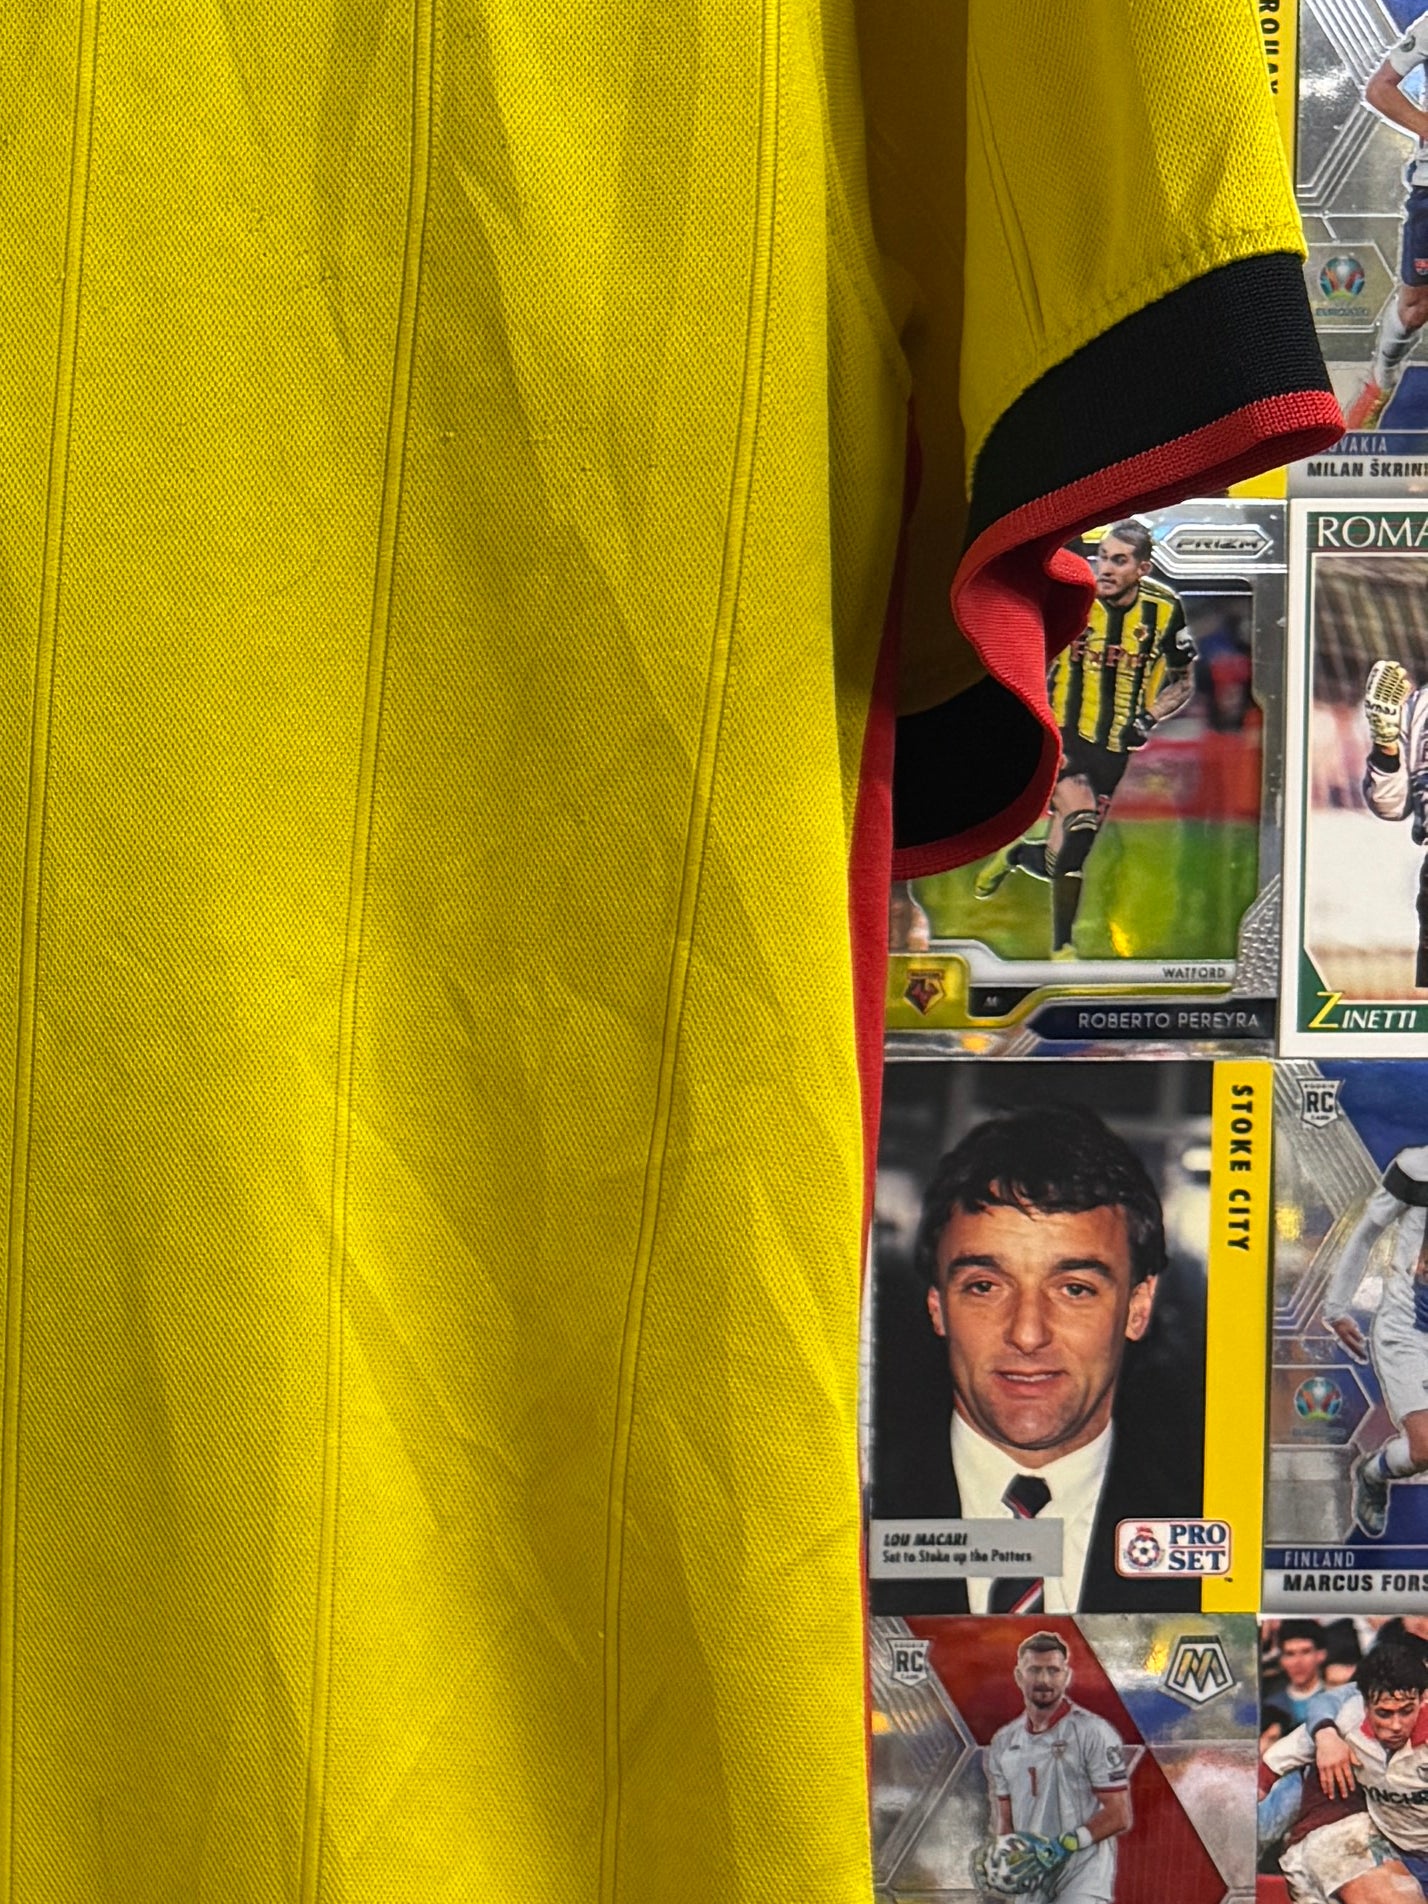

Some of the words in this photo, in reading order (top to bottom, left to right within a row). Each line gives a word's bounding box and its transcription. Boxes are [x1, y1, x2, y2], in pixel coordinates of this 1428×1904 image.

[1307, 459, 1364, 478] MILAN
[1315, 514, 1428, 549] ROMA
[1162, 967, 1227, 980] WATFORD
[1077, 1012, 1171, 1030] ROBERTO
[1177, 1010, 1260, 1029] PEREYRA
[1307, 990, 1416, 1031] ZINETTI
[1231, 1084, 1255, 1173] STOKE
[1225, 1190, 1252, 1252] CITY
[883, 1532, 909, 1547] LOU
[913, 1532, 969, 1547] MACARI
[1168, 1523, 1228, 1545] PRO
[1168, 1549, 1228, 1572] SET
[1283, 1550, 1355, 1568] FINLAND
[1283, 1572, 1374, 1593] MARCUS
